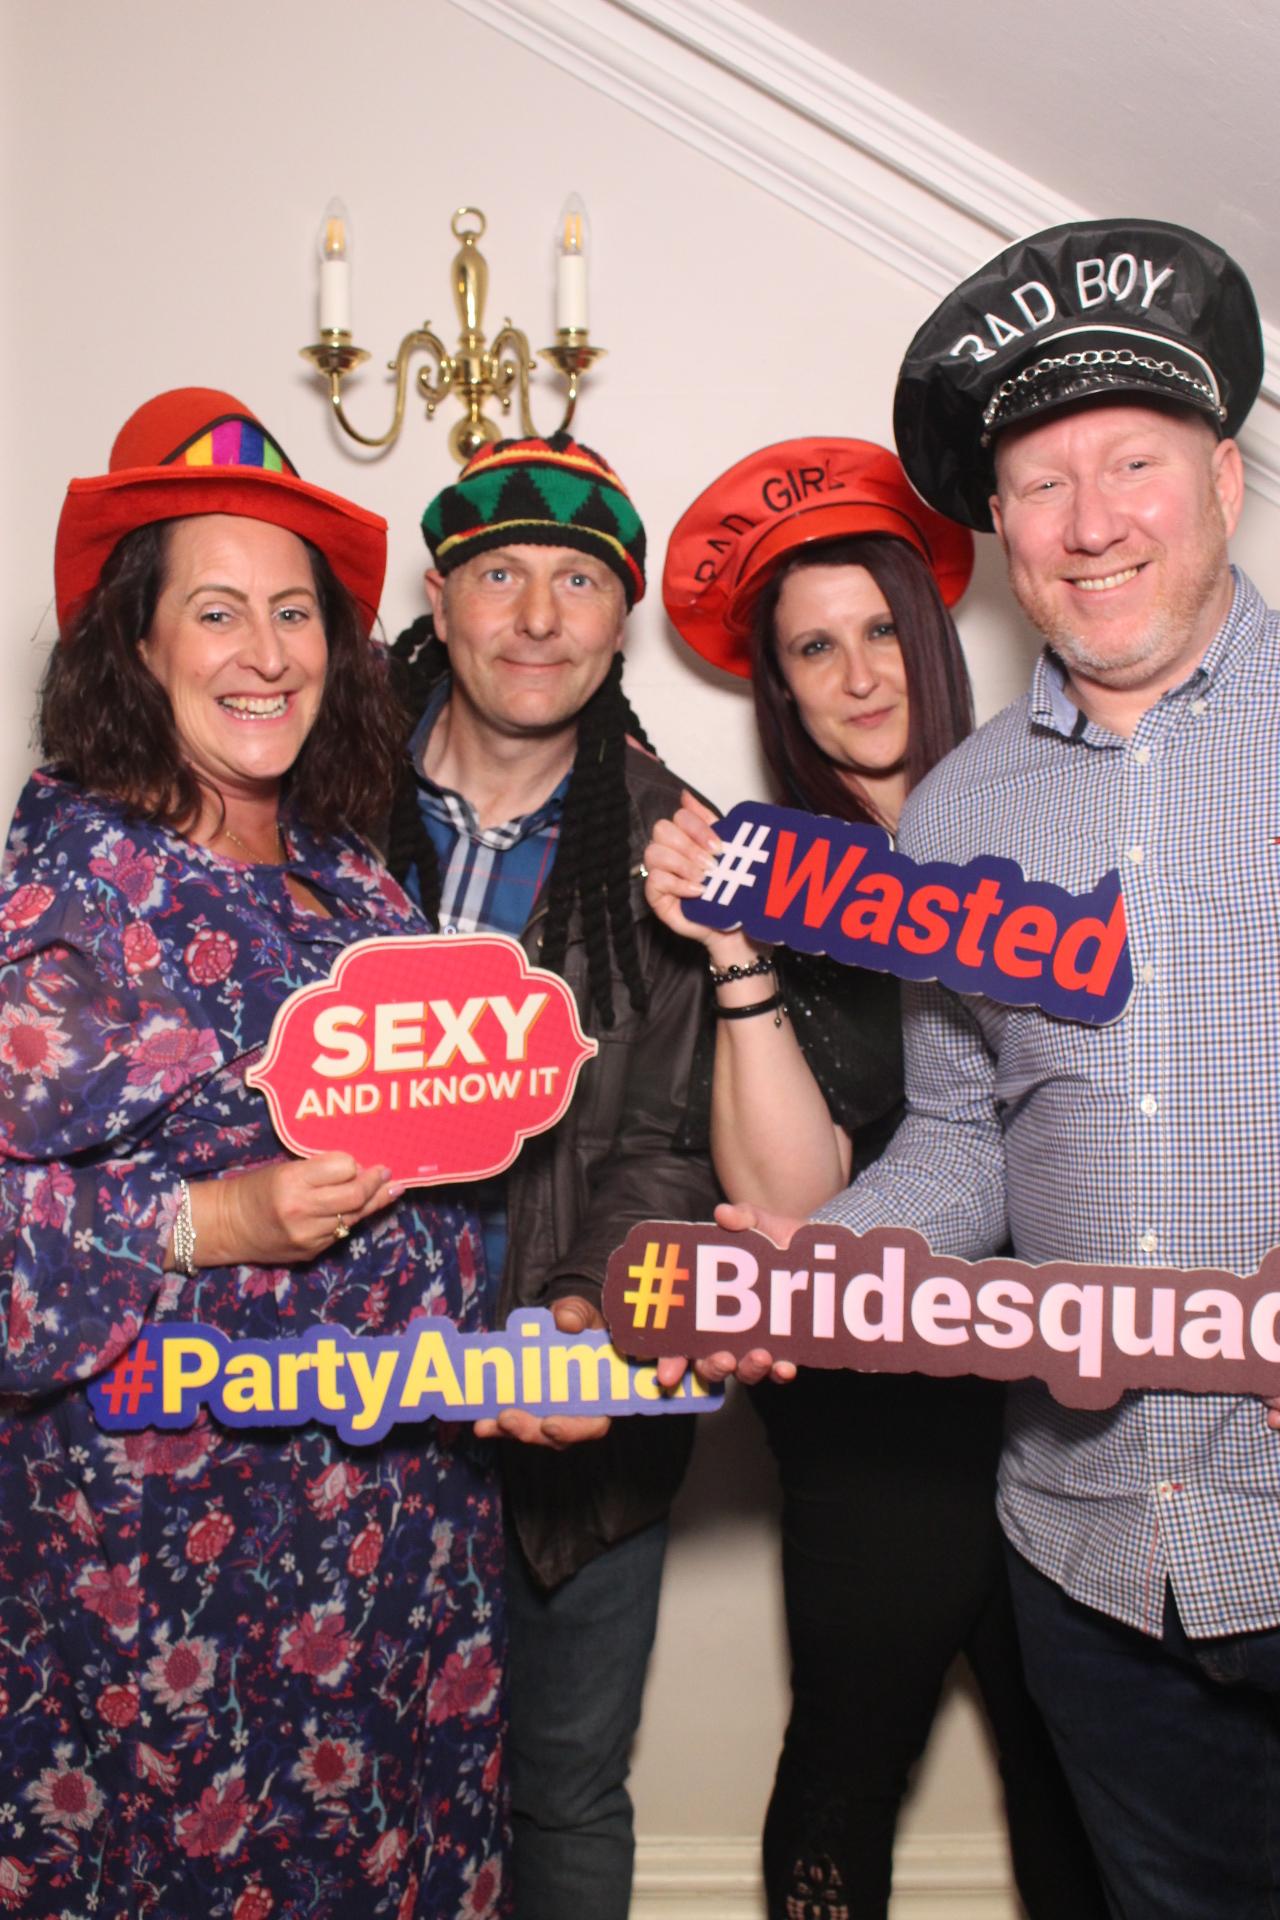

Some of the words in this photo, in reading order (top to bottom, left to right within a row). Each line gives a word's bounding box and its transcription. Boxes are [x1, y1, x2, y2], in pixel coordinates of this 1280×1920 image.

[1076, 253, 1175, 309] BOY
[762, 459, 845, 513] GIRL
[700, 821, 1127, 997] #Wasted
[311, 993, 551, 1080] SEXY
[295, 1083, 381, 1120] AND
[390, 1081, 399, 1111] I
[409, 1070, 522, 1109] KNOW
[529, 1066, 560, 1097] IT
